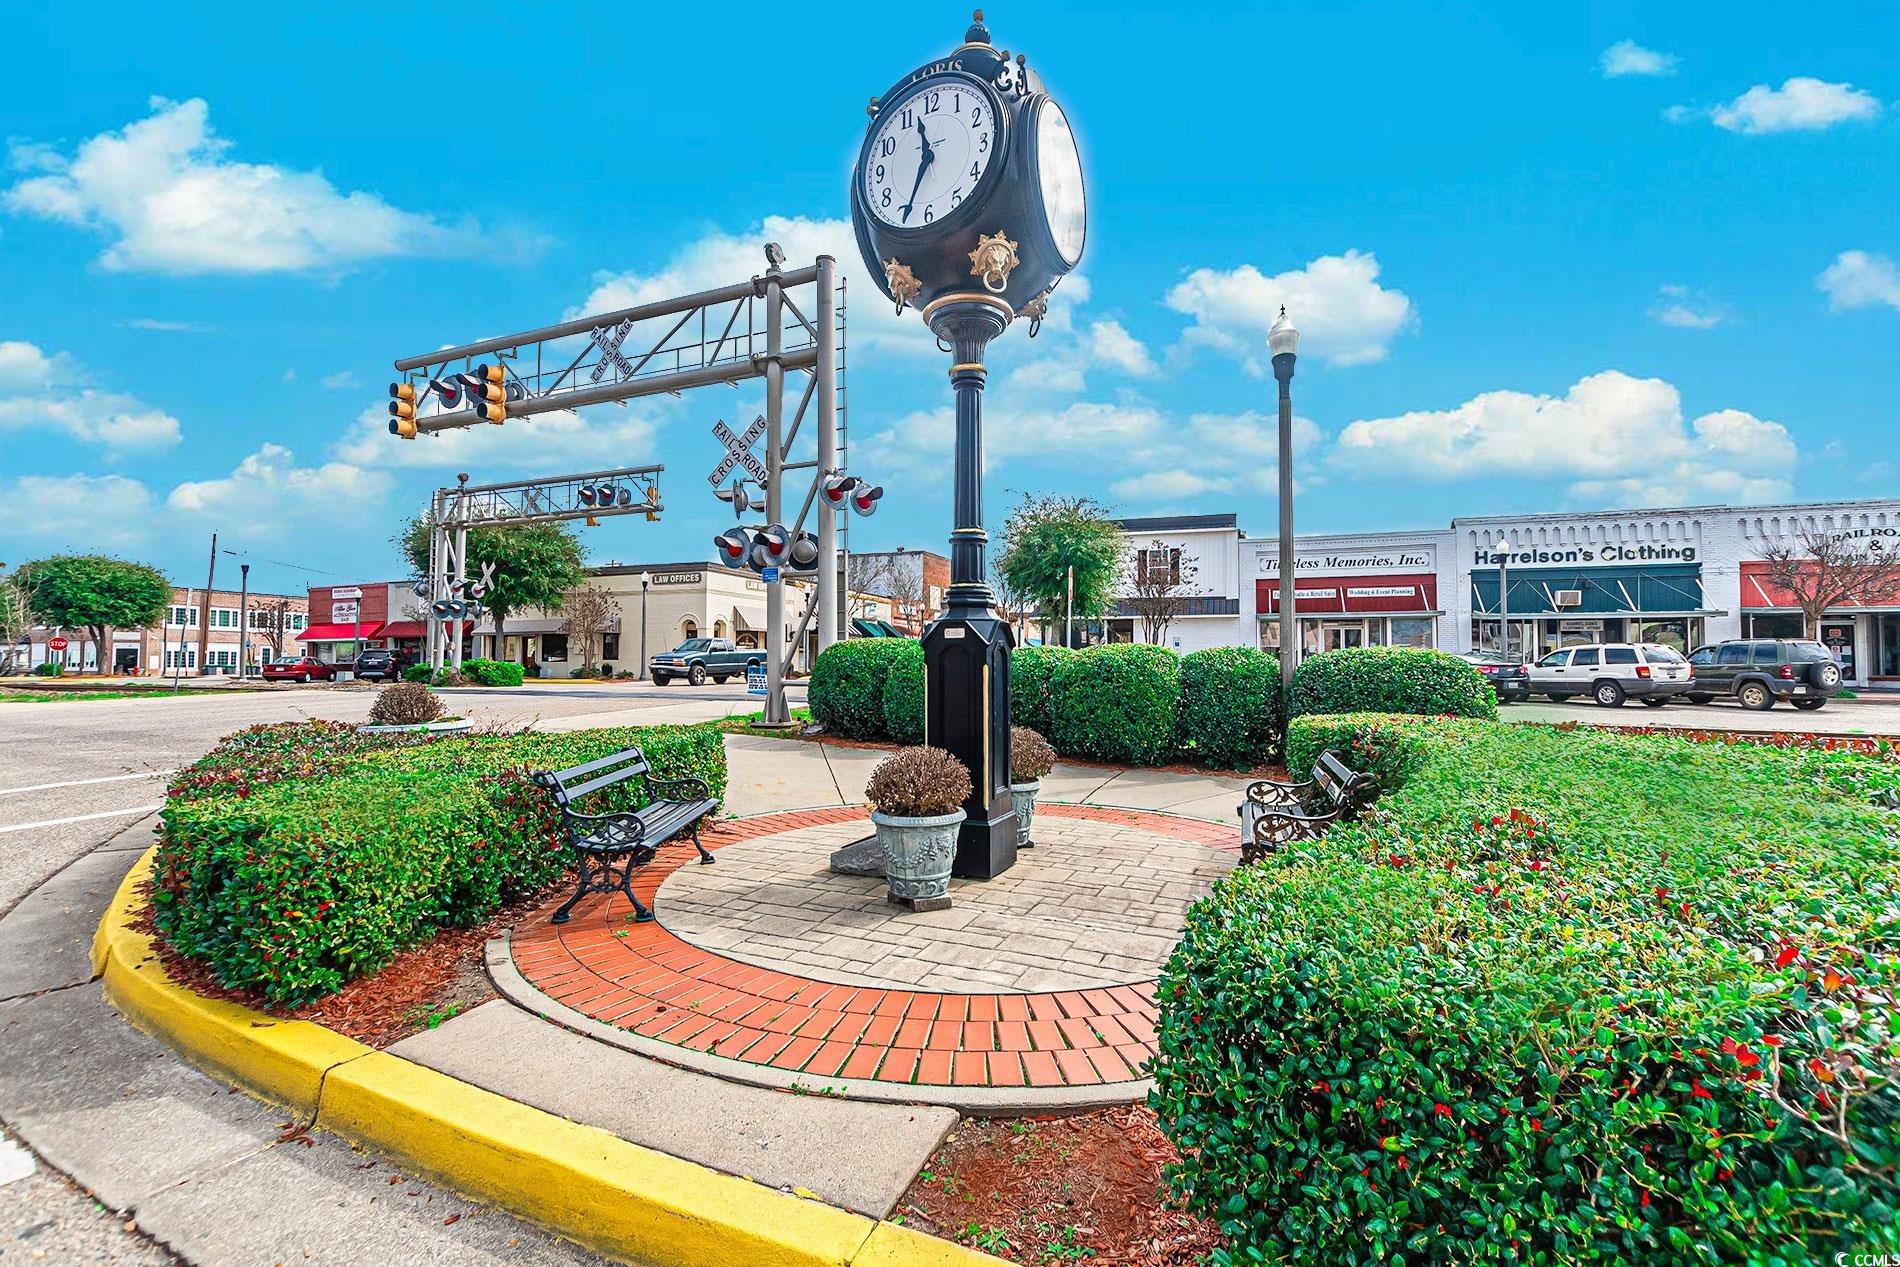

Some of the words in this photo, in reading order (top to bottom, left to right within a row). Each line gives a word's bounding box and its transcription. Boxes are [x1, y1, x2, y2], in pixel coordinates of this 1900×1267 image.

[912, 59, 963, 82] LORIS
[923, 92, 940, 115] 12
[954, 93, 961, 114] 1
[901, 109, 913, 131] 11
[971, 107, 982, 128] 2
[880, 136, 896, 159] 10
[979, 132, 988, 153] 3
[875, 164, 885, 184] 9
[969, 160, 981, 182] 4
[881, 187, 892, 208] 8
[951, 187, 962, 209] 5
[923, 204, 934, 223] 6
[593, 321, 631, 382] CROSSING
[711, 418, 766, 484] CROSSING
[1833, 528, 1900, 543] RAILRO
[1869, 539, 1883, 551] &
[1266, 558, 1320, 570] Tiless
[1323, 555, 1394, 568] Memories,
[1398, 554, 1425, 566] Inc.
[1474, 547, 1594, 565] Harrelson's
[1600, 544, 1696, 562] Clothing
[654, 575, 669, 584] LAW
[670, 574, 700, 583] OFFICES
